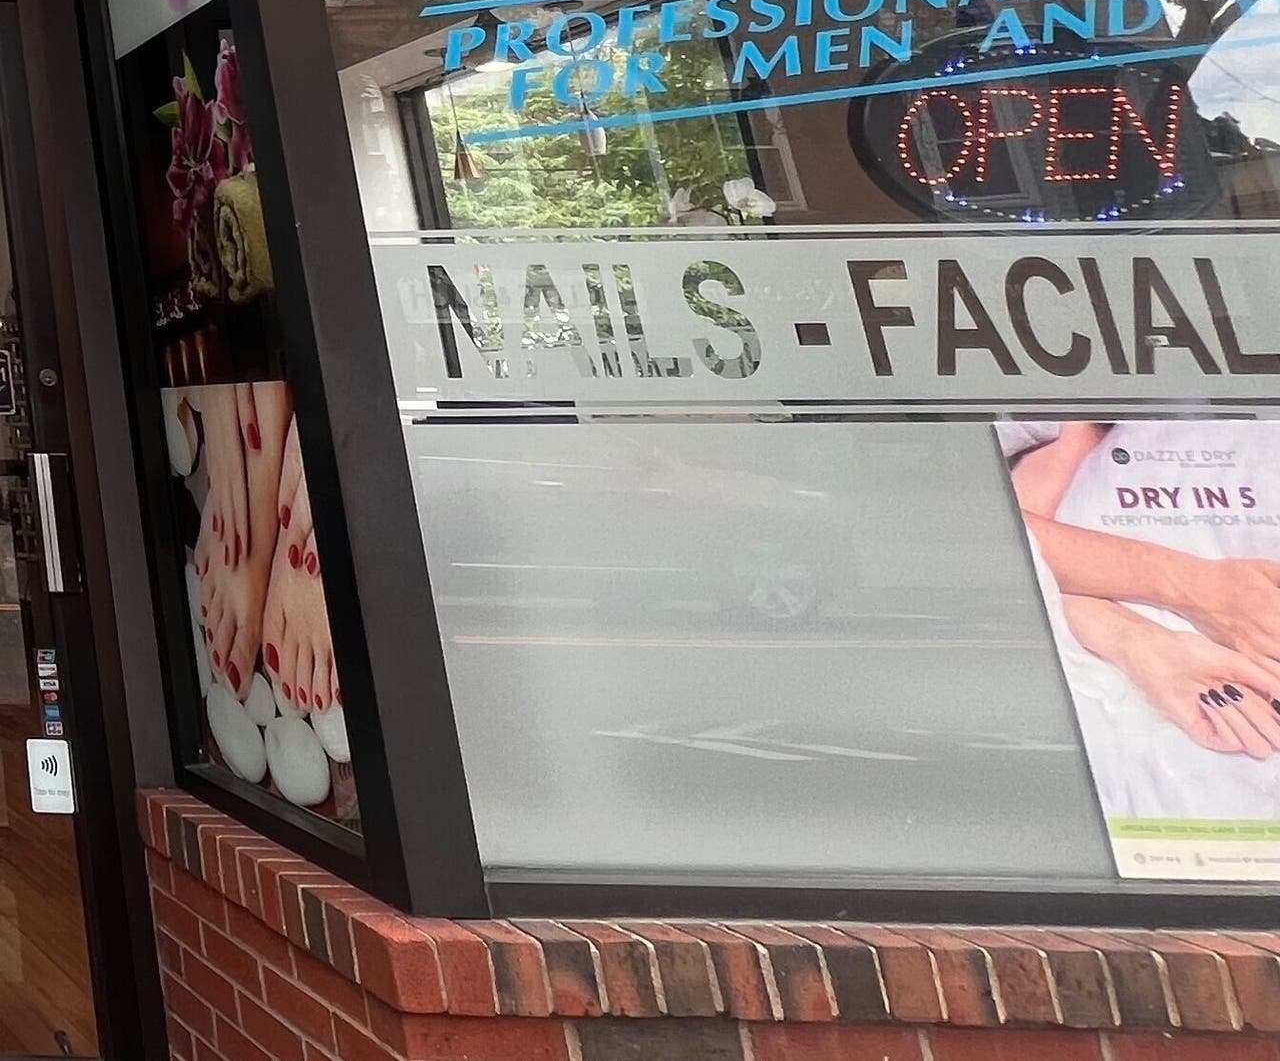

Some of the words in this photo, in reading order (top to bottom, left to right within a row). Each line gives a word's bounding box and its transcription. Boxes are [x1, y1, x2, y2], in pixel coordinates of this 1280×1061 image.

[509, 51, 667, 113] FOR
[731, 18, 913, 84] MEN
[896, 82, 1181, 187] OPEN
[427, 259, 763, 379] NAILS
[794, 322, 832, 345] -
[846, 256, 1280, 376] FACIAL
[1116, 487, 1181, 509] DRY
[1192, 487, 1231, 509] IN
[1133, 450, 1195, 463] DAZZLE
